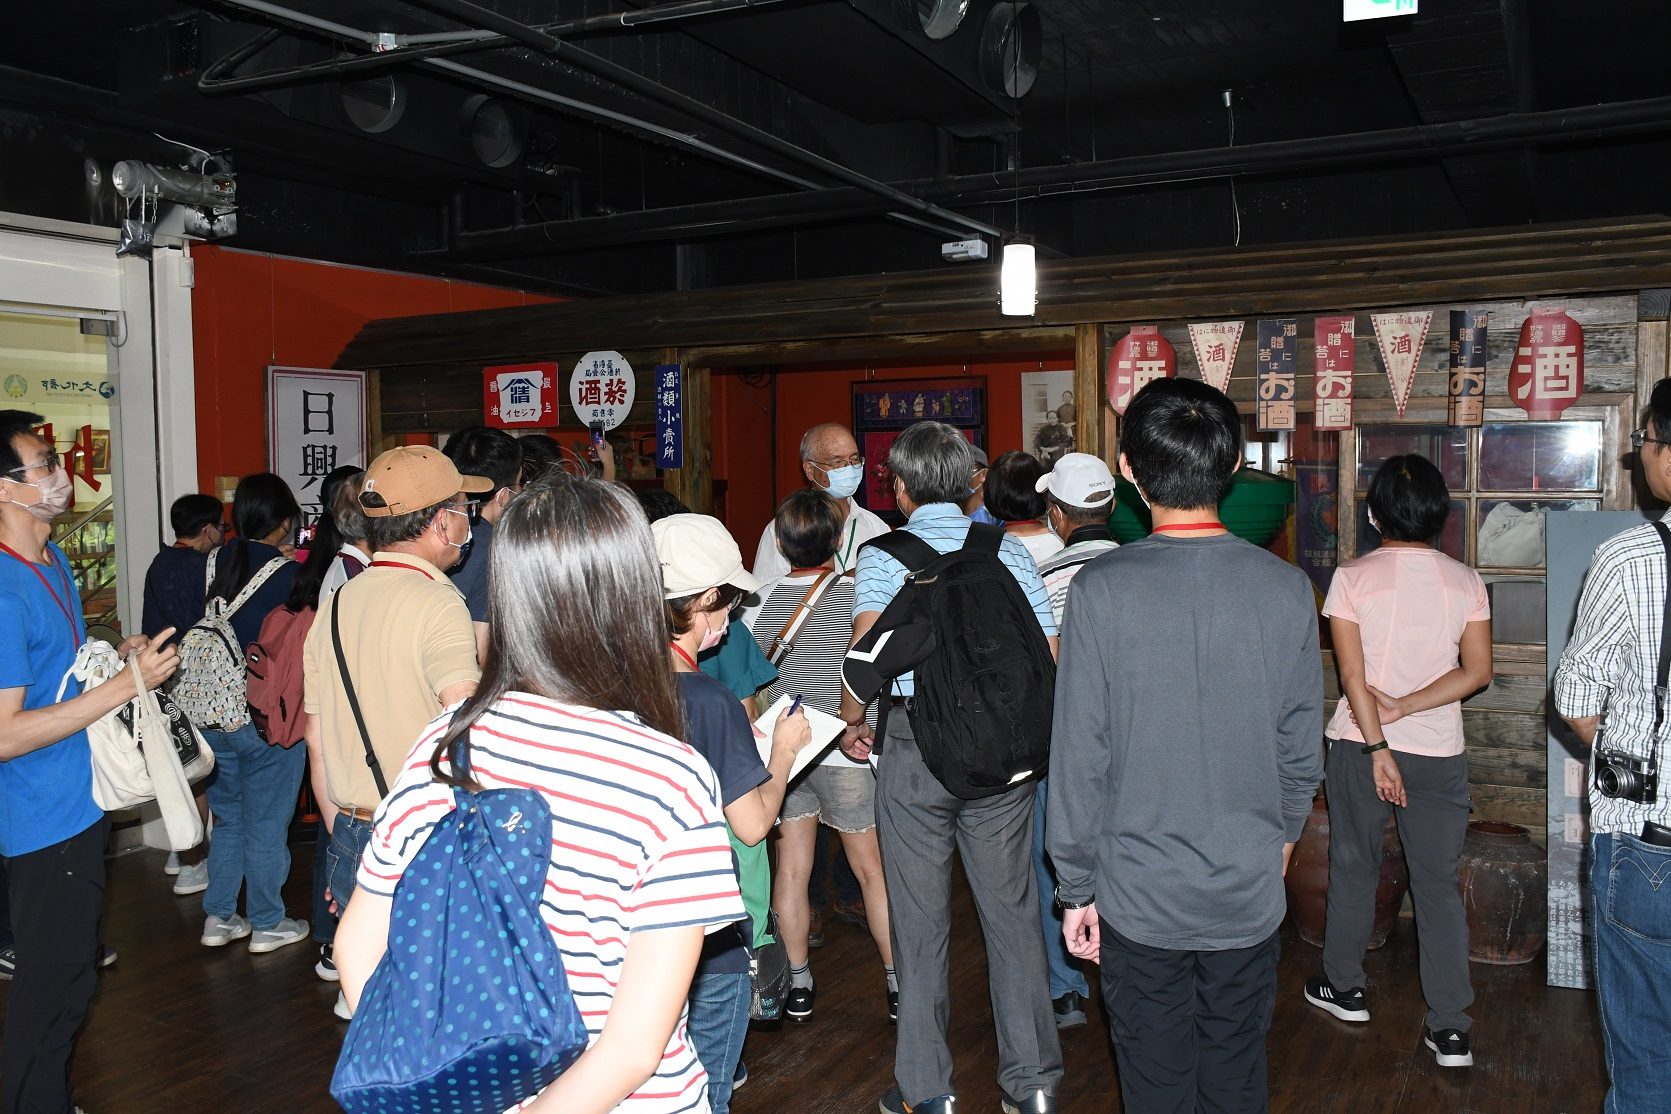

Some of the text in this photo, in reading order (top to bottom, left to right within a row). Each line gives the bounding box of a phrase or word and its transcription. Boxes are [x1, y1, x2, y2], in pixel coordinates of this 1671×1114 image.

[1206, 343, 1226, 363] 酒
[1390, 334, 1412, 355] 酒
[1517, 345, 1578, 399] 酒
[662, 371, 676, 461] 酒類小賣所
[1260, 371, 1295, 429] お酒
[1315, 369, 1353, 427] お酒
[1448, 365, 1485, 426] お酒
